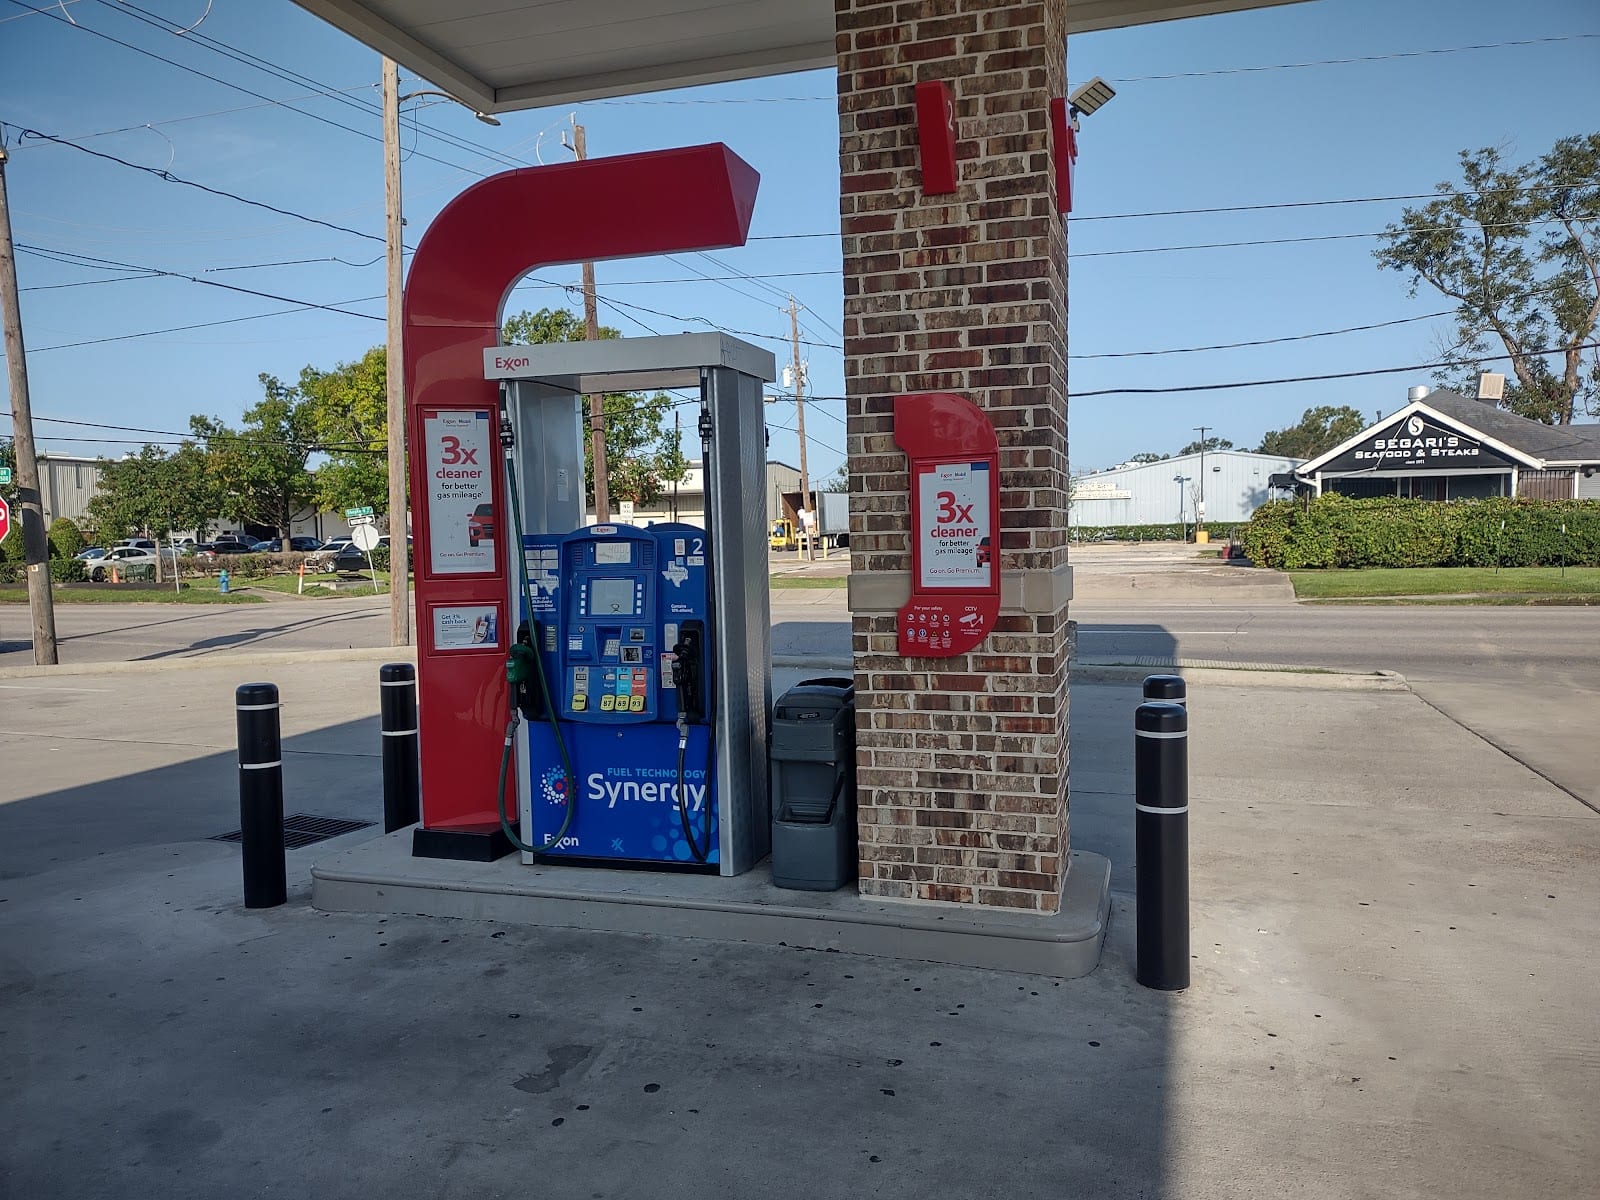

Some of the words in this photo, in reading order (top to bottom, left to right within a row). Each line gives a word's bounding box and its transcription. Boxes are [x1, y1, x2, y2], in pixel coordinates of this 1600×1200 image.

[947, 99, 954, 131] 2
[495, 357, 529, 371] Exxon
[1374, 436, 1459, 449] SEGARI'S
[441, 435, 478, 465] 3x
[1355, 450, 1412, 459] SEAFOOD
[1415, 448, 1426, 457] &
[1430, 448, 1479, 456] STEAKS
[435, 467, 482, 479] cleaner
[441, 482, 453, 490] for
[454, 482, 478, 490] better
[436, 492, 451, 500] gas
[936, 491, 974, 523] 3x
[930, 525, 978, 538] cleaner
[692, 538, 704, 555] 2
[939, 539, 949, 547] for
[949, 539, 970, 547] better
[935, 548, 946, 556] gas
[607, 767, 632, 777] FUEL
[635, 768, 706, 778] TECHNOOGY
[587, 773, 706, 812] Synergy
